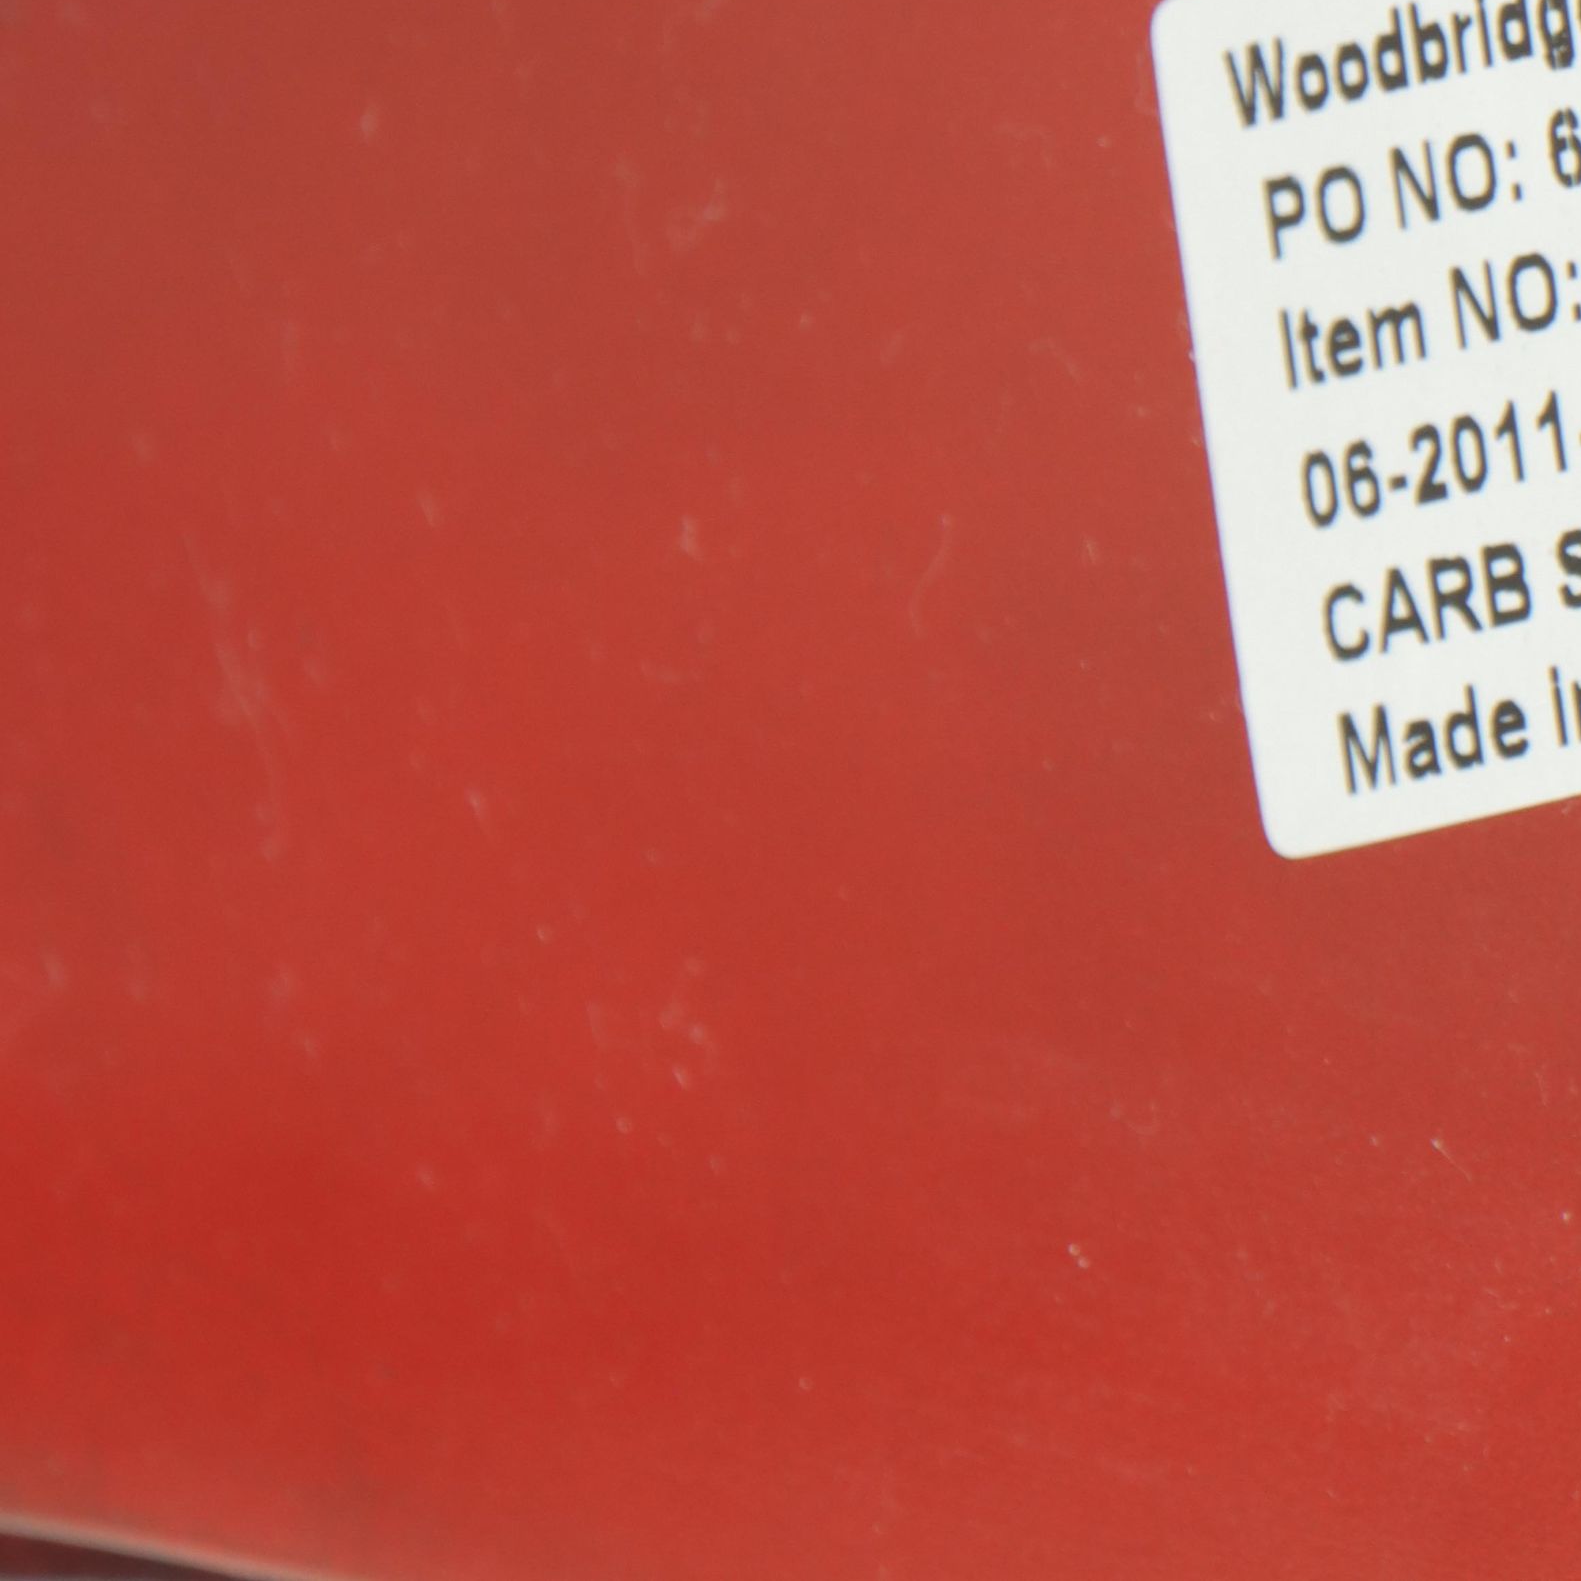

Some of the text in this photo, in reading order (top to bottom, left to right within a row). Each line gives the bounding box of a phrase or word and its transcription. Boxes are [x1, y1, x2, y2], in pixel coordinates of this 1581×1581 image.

[1267, 167, 1364, 256] PO
[1393, 134, 1521, 224] NO:
[1280, 304, 1425, 386] Item
[1327, 544, 1531, 660] CARB
[1341, 687, 1528, 791] Made
